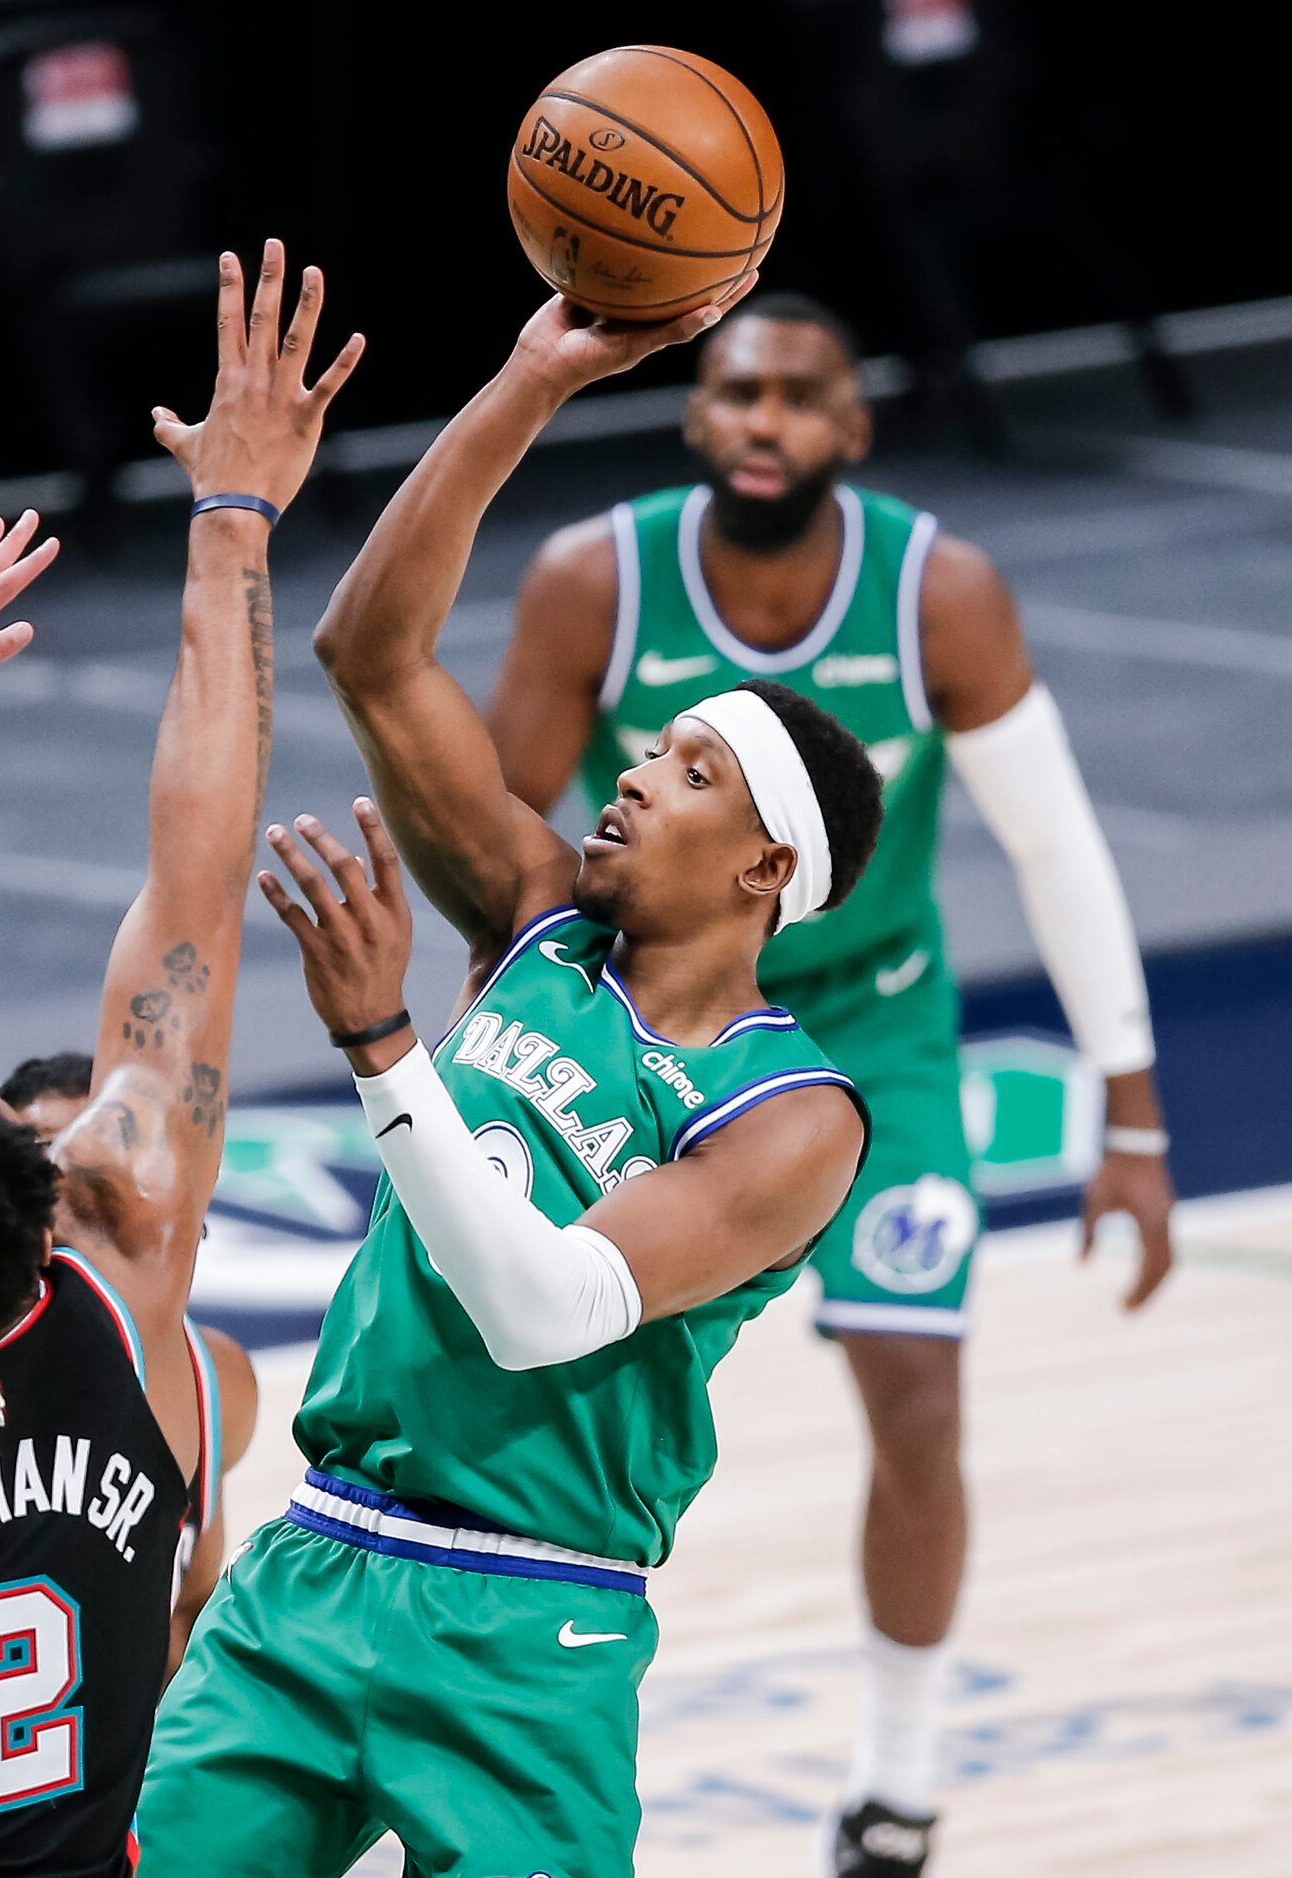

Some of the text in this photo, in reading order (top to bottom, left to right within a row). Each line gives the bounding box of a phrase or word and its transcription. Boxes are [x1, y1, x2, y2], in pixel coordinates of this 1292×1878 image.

[523, 115, 685, 237] SPALDING
[642, 1050, 705, 1109] chime
[87, 1452, 155, 1562] SR.
